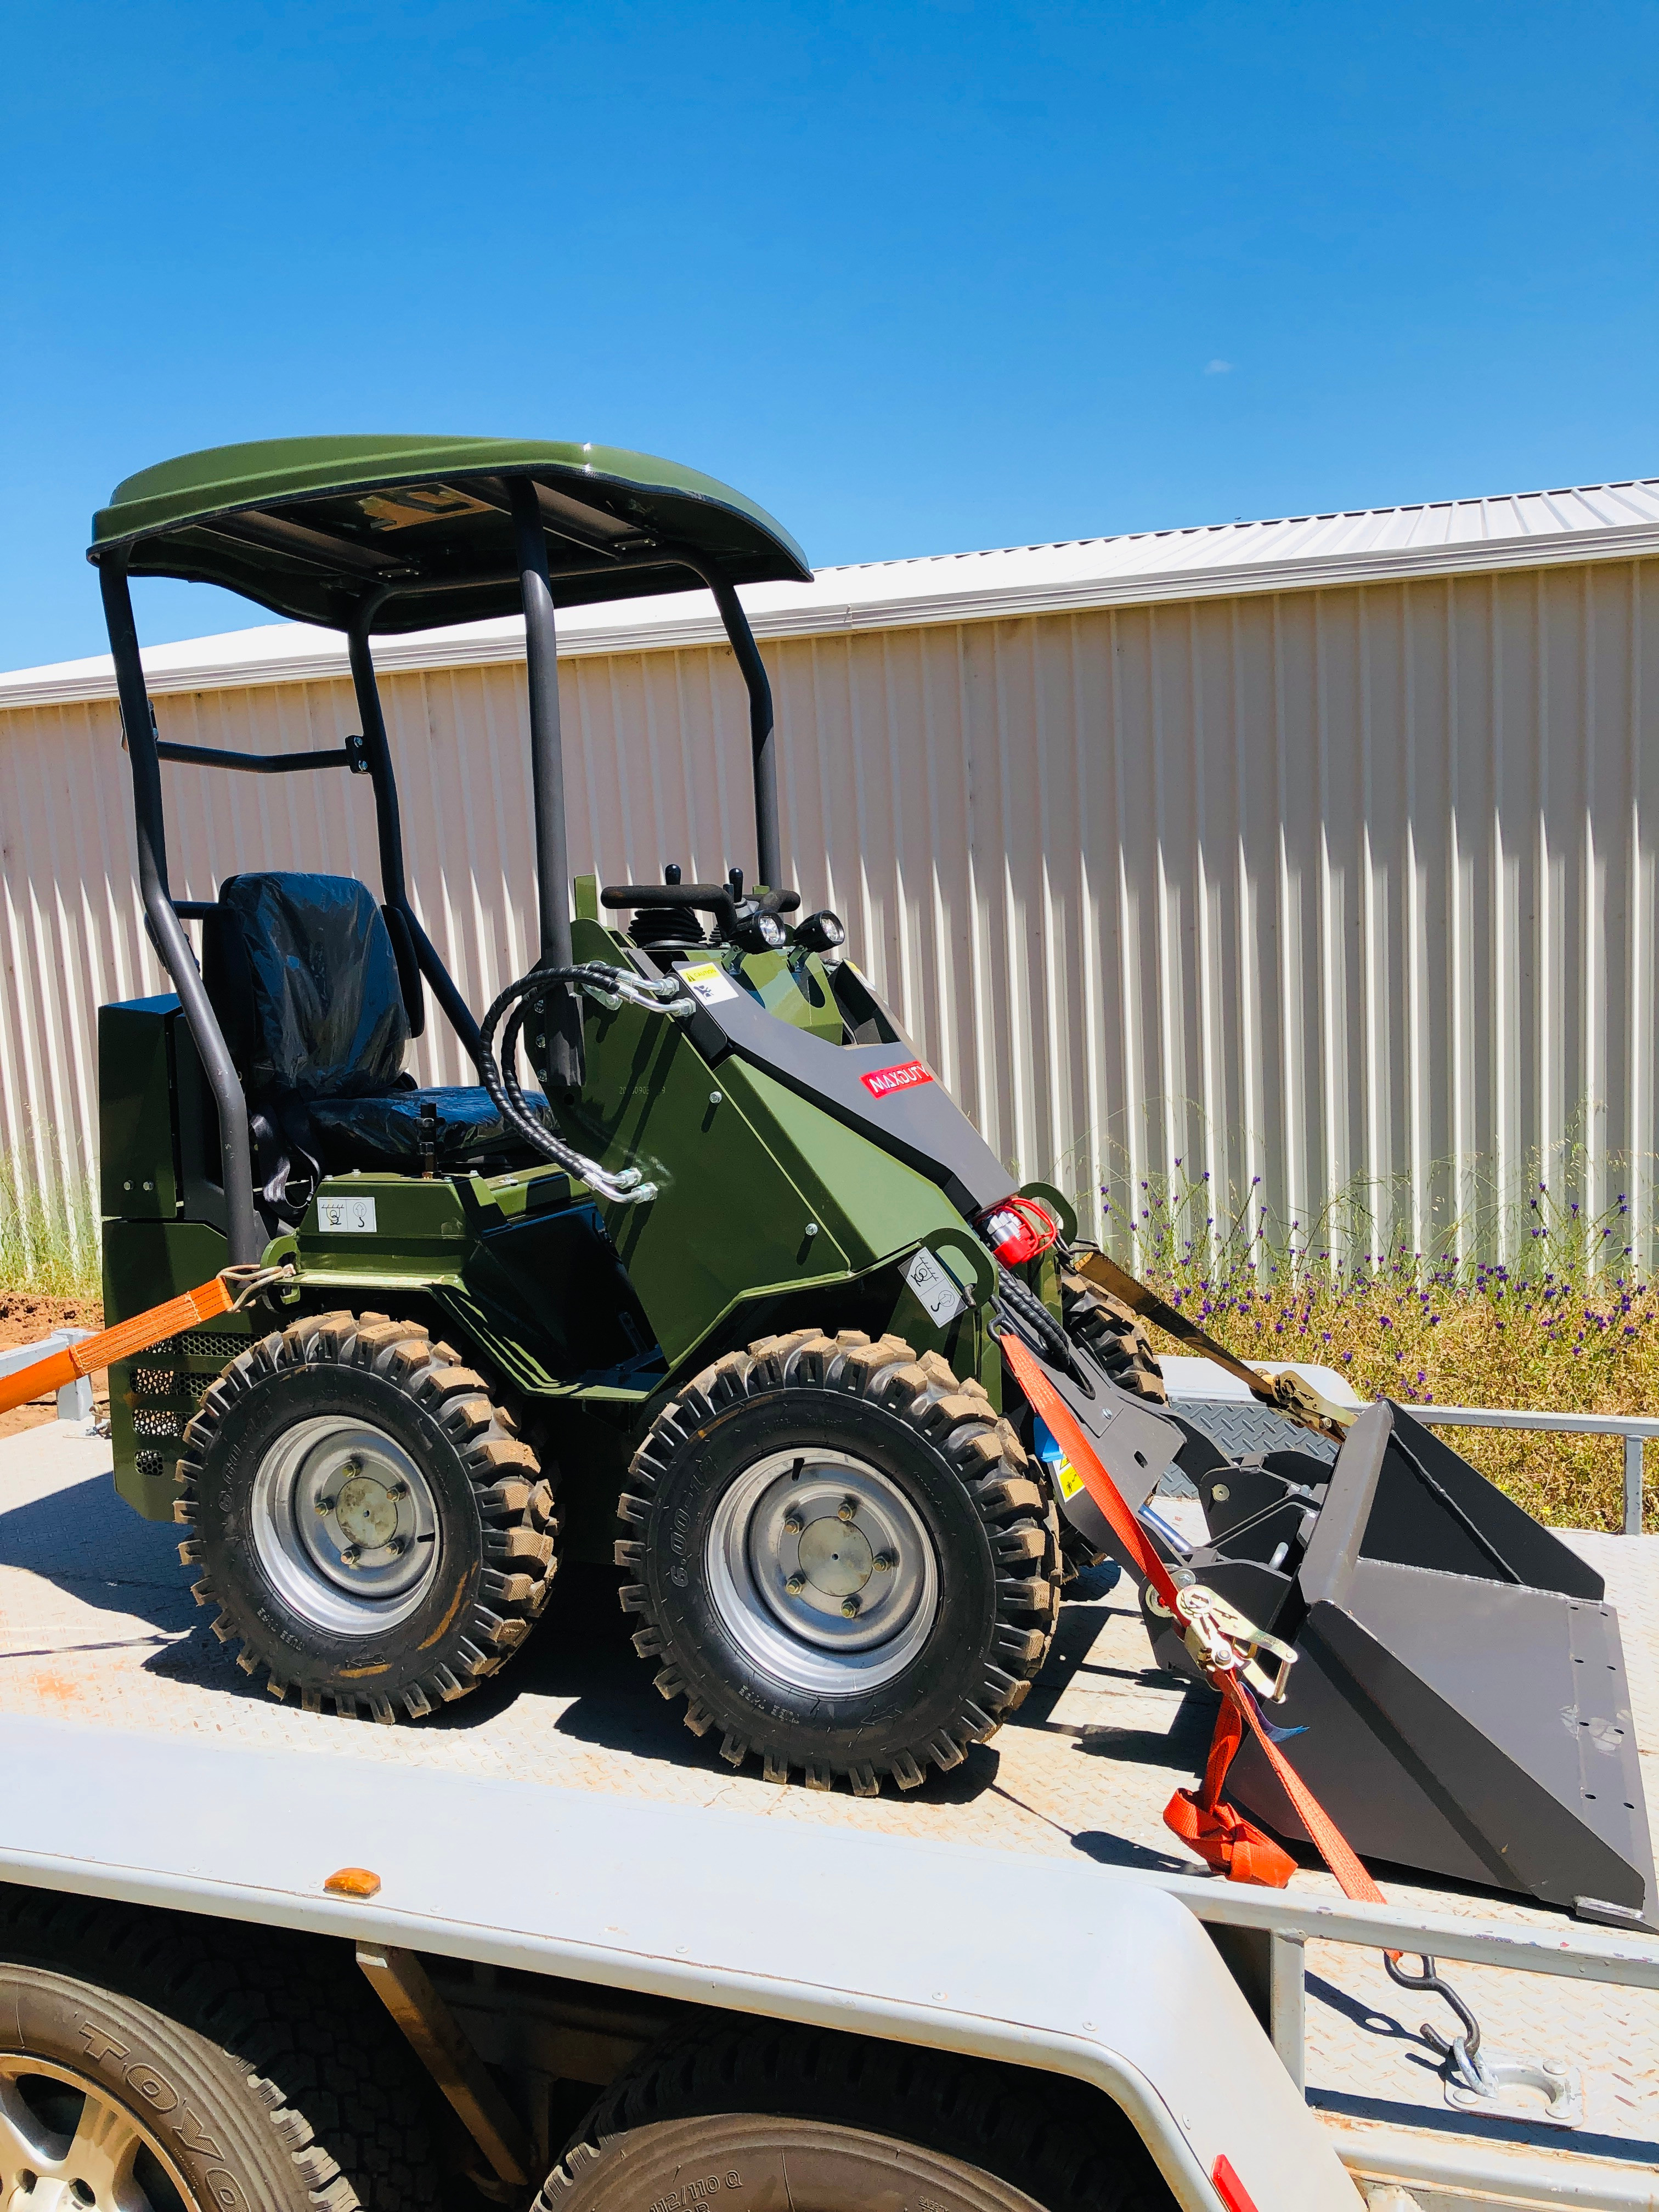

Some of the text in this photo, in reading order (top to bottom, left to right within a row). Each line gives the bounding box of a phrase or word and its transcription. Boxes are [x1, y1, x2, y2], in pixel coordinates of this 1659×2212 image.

[693, 969, 716, 978] CAUTION
[868, 1064, 929, 1093] MAXDUTY
[78, 2021, 251, 2212] TOYO
[725, 2170, 744, 2190] Q
